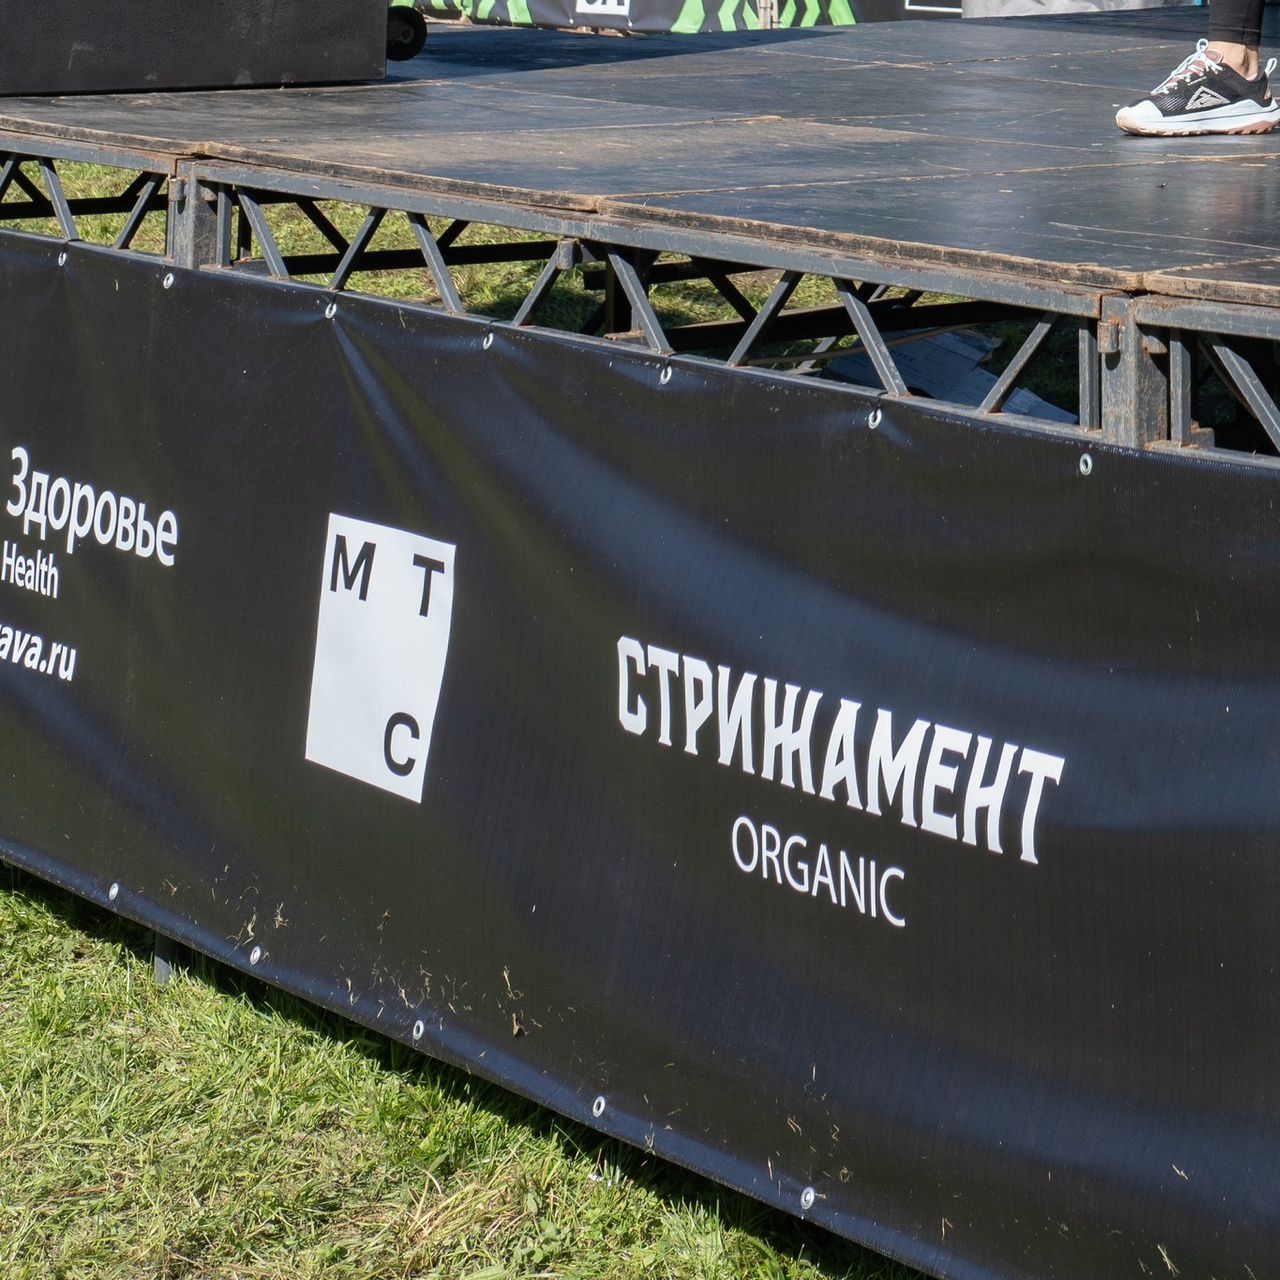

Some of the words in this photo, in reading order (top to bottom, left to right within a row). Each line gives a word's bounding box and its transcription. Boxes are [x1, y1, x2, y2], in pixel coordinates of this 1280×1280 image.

[6, 446, 178, 567] Здоровье
[1, 540, 60, 599] Health
[0, 624, 77, 682] ava.ru
[616, 635, 1066, 865] СТРИЖАМЕНТ
[731, 815, 906, 928] ORGANIC
